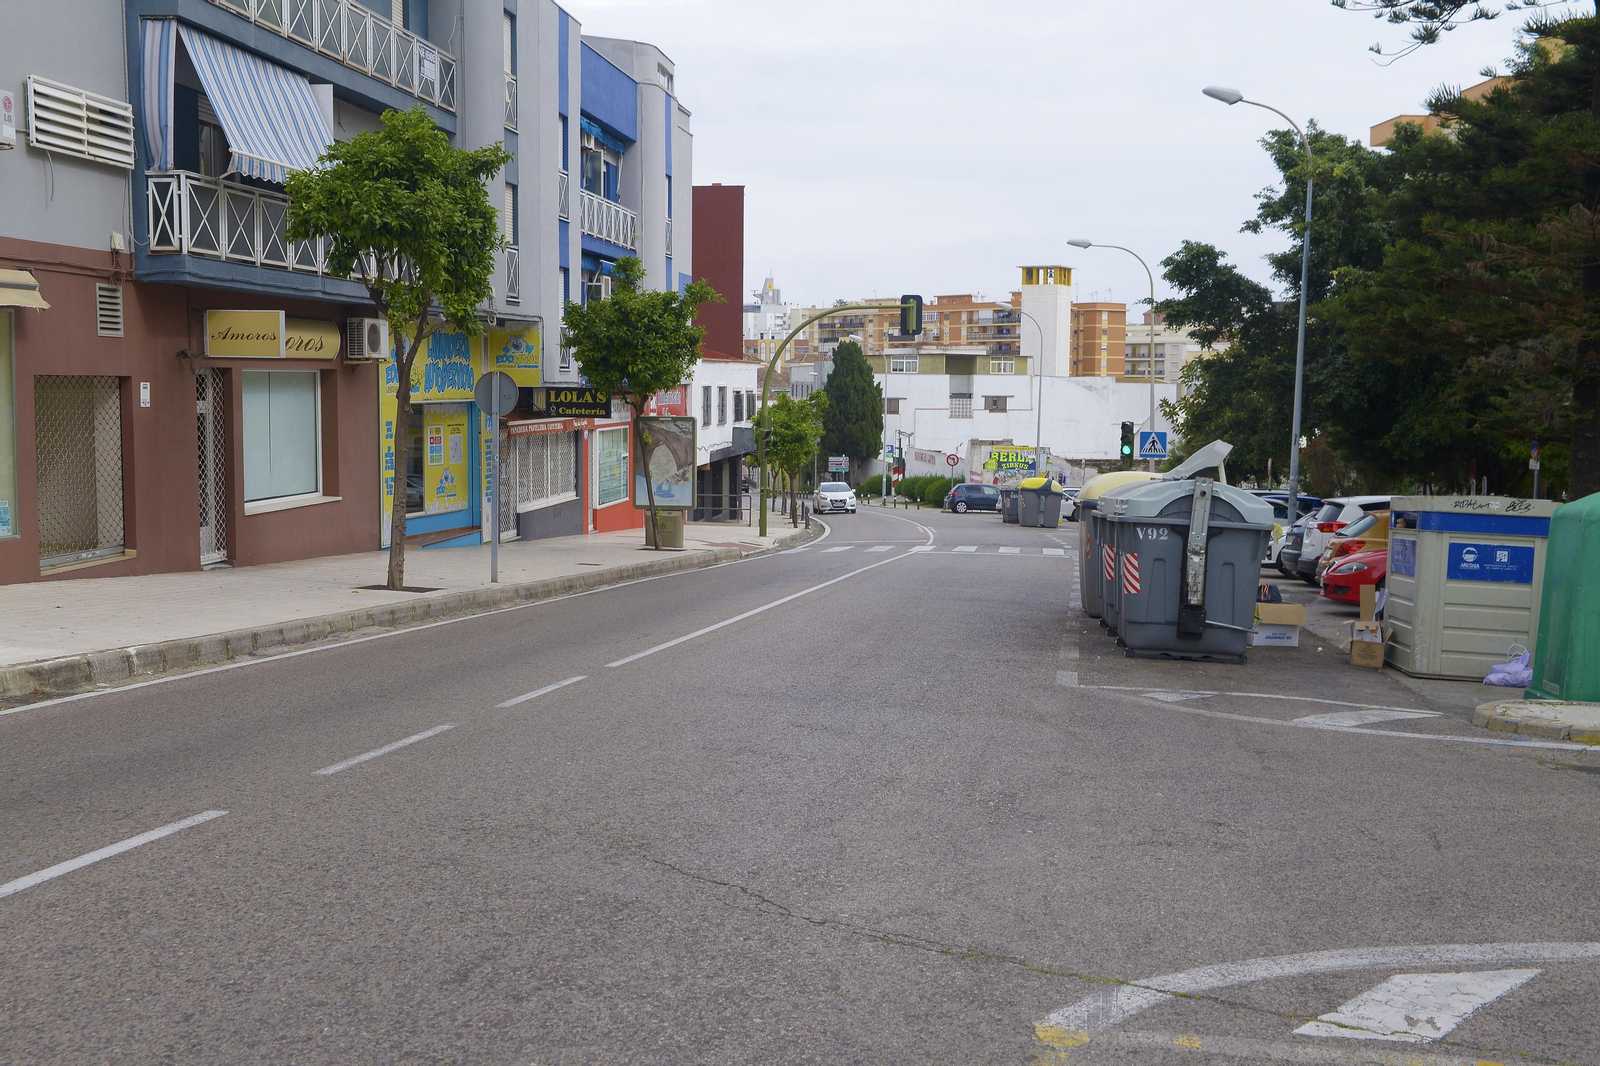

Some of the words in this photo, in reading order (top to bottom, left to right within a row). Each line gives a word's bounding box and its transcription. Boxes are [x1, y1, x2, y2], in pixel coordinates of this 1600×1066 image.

[3, 113, 12, 122] LG
[211, 326, 278, 341] Amoros
[423, 361, 475, 394] AUTOSERVICIO
[549, 389, 607, 403] LOLA'S
[558, 406, 606, 415] Cafetería
[1135, 527, 1169, 540] V92
